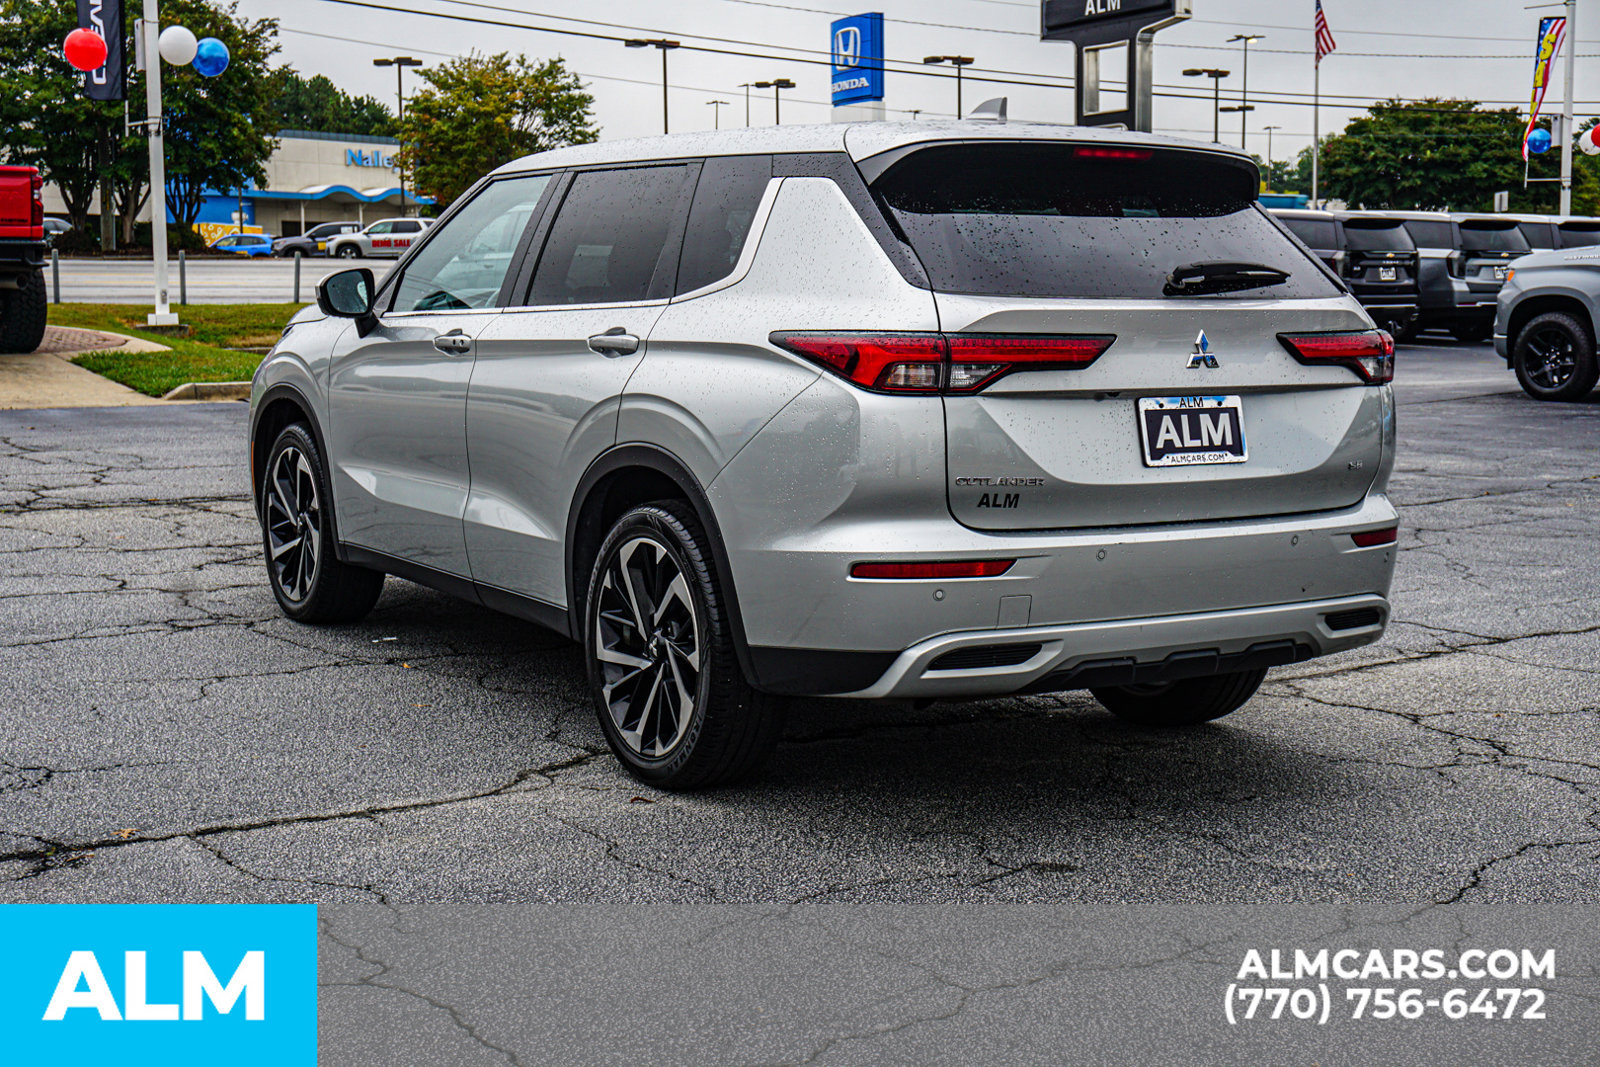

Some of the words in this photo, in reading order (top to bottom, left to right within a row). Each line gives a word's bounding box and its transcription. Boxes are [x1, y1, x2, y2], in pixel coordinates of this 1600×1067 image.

[1085, 0, 1121, 16] ALM
[832, 77, 870, 93] HONDA
[345, 148, 401, 173] Nalle
[1180, 396, 1204, 408] ALM
[1156, 412, 1233, 449] ALM
[1171, 454, 1226, 464] ALMCARS.COM
[956, 476, 1046, 486] OUTLANDER
[976, 492, 1020, 509] ALM
